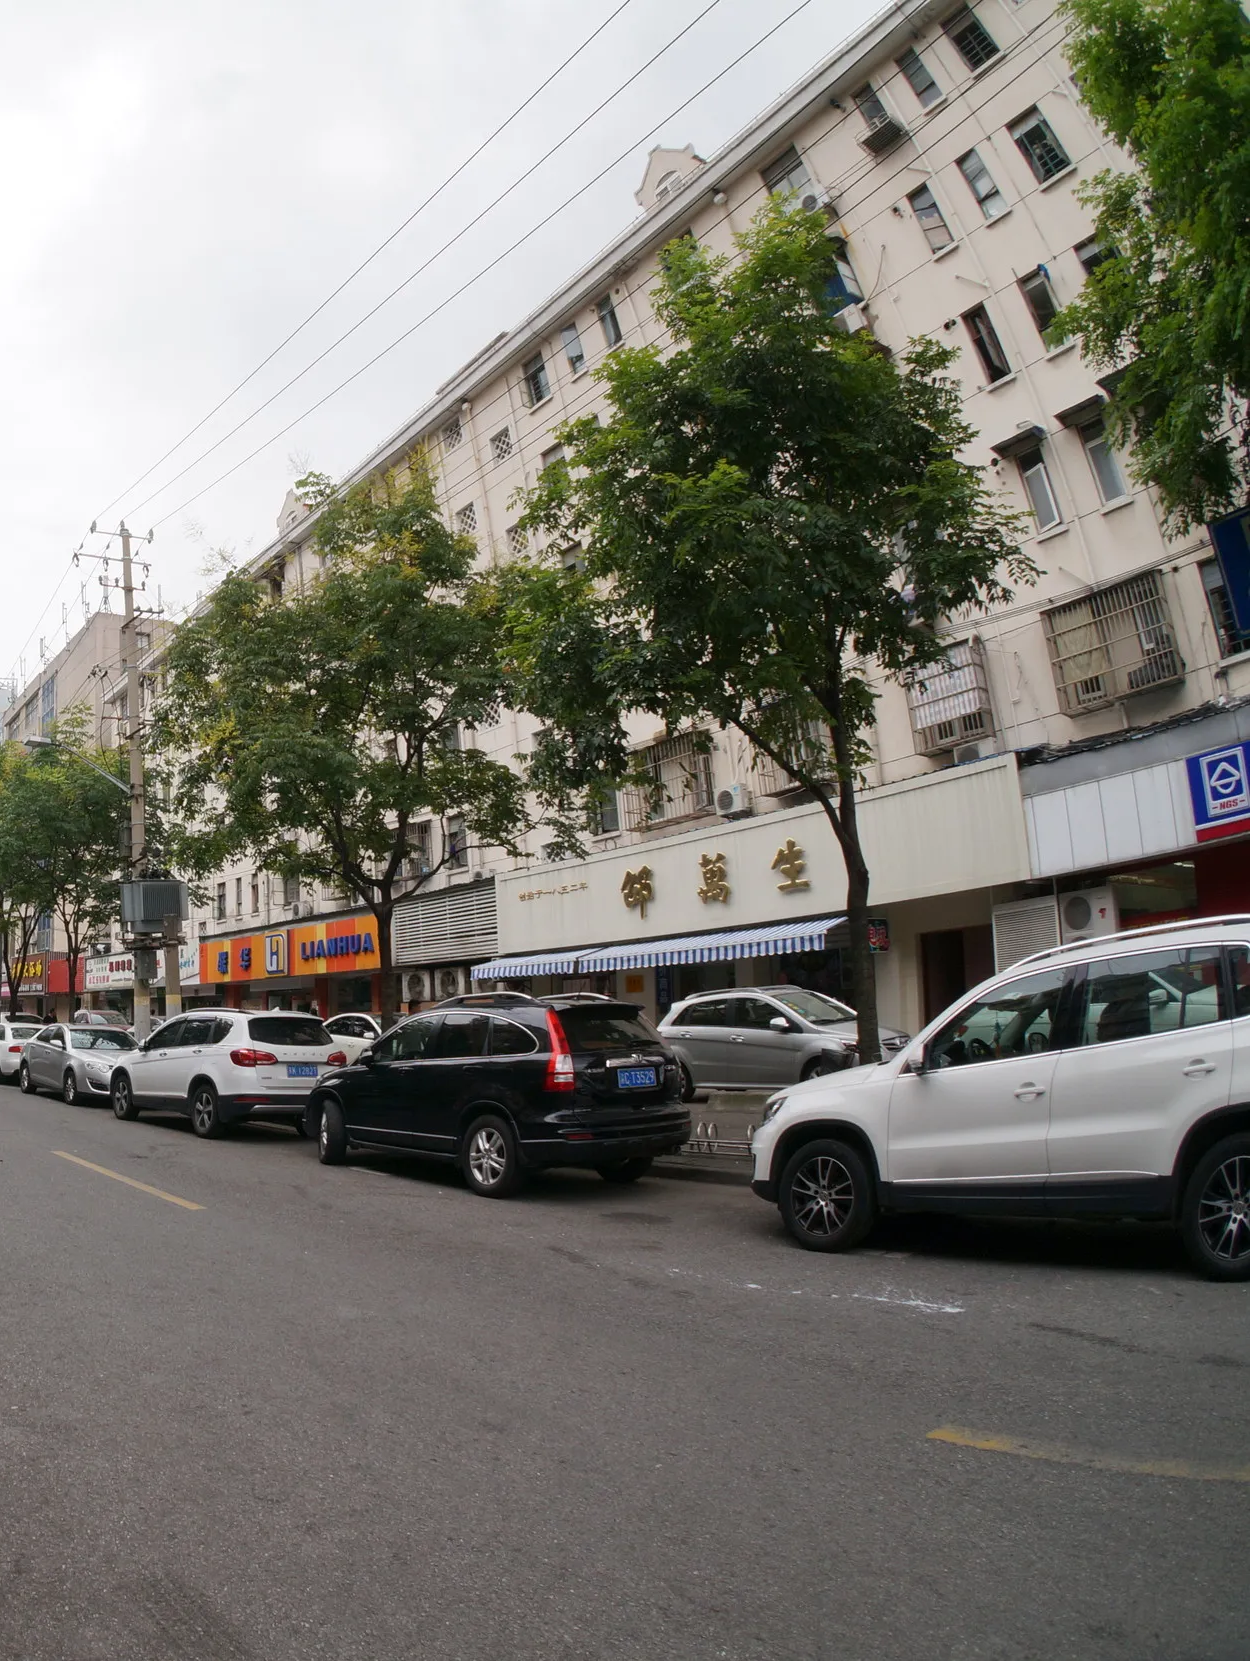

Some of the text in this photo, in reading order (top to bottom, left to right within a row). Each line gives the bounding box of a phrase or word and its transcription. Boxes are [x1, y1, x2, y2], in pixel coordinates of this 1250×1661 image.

[1219, 798, 1239, 810] NGS
[621, 837, 811, 919] 邵萬生
[301, 932, 375, 961] LIANHUA
